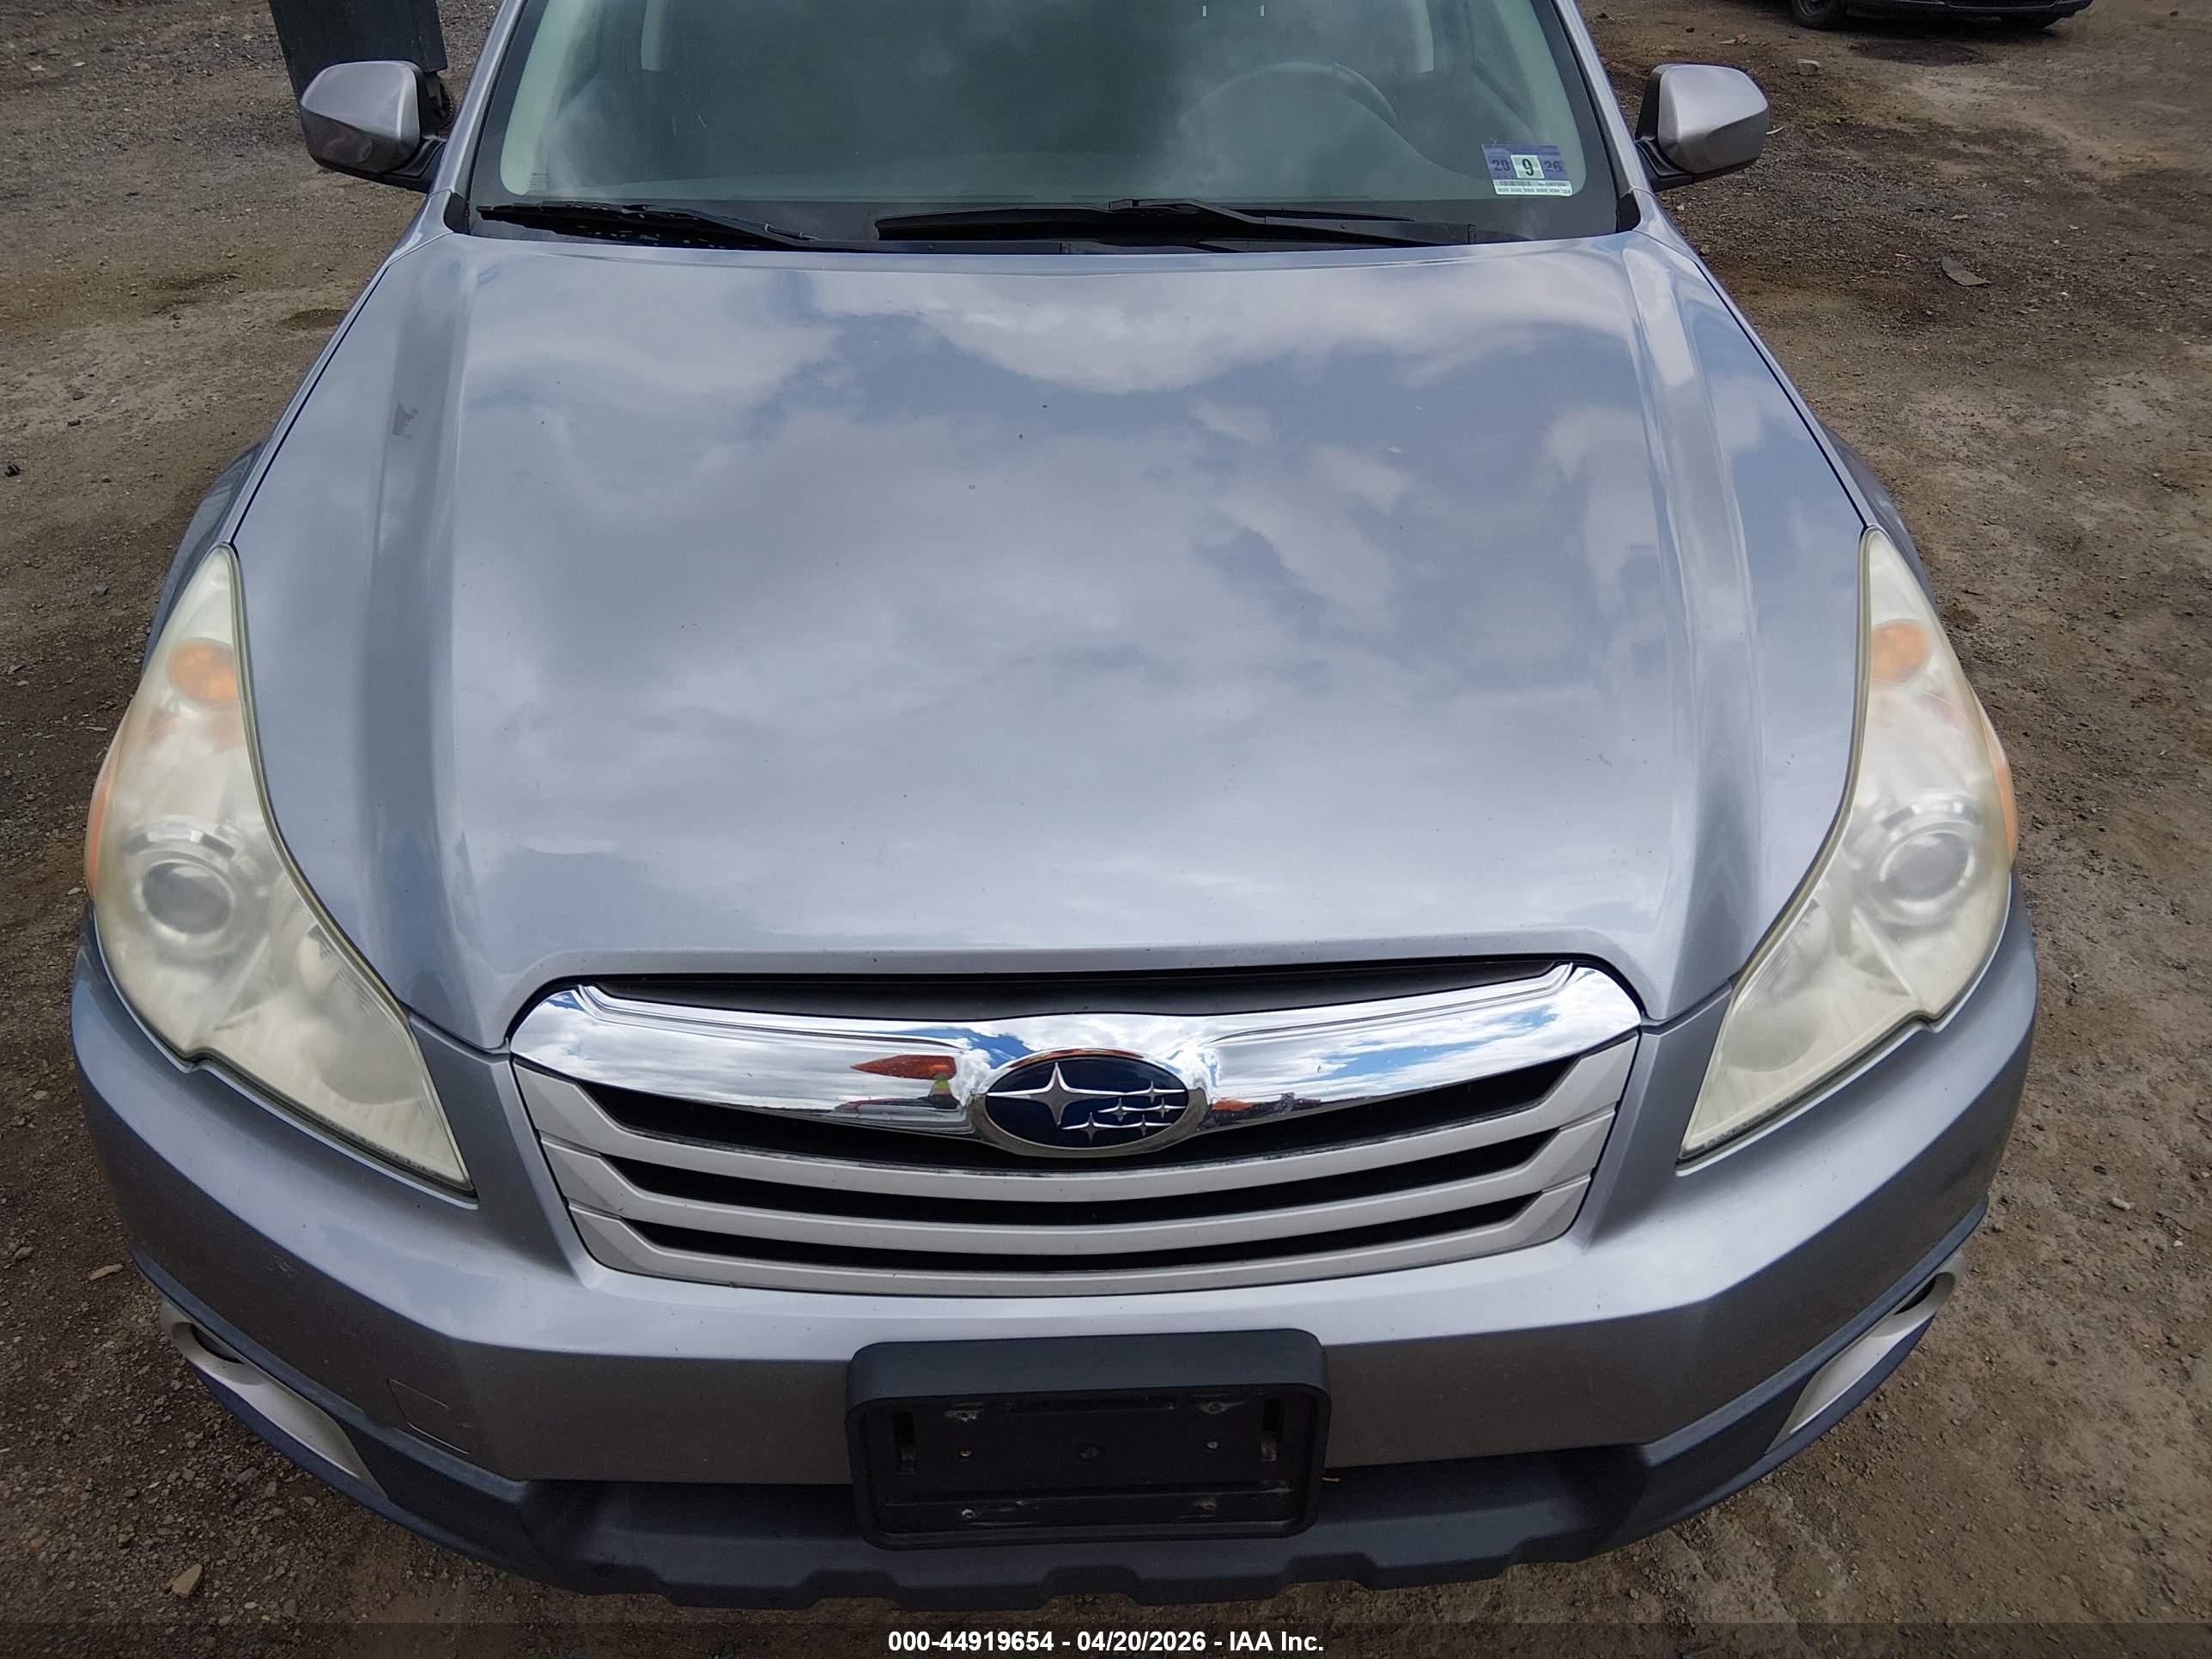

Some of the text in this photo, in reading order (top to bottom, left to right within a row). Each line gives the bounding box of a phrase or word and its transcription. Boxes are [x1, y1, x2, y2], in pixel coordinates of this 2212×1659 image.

[1492, 158, 1563, 176] 20 9 26
